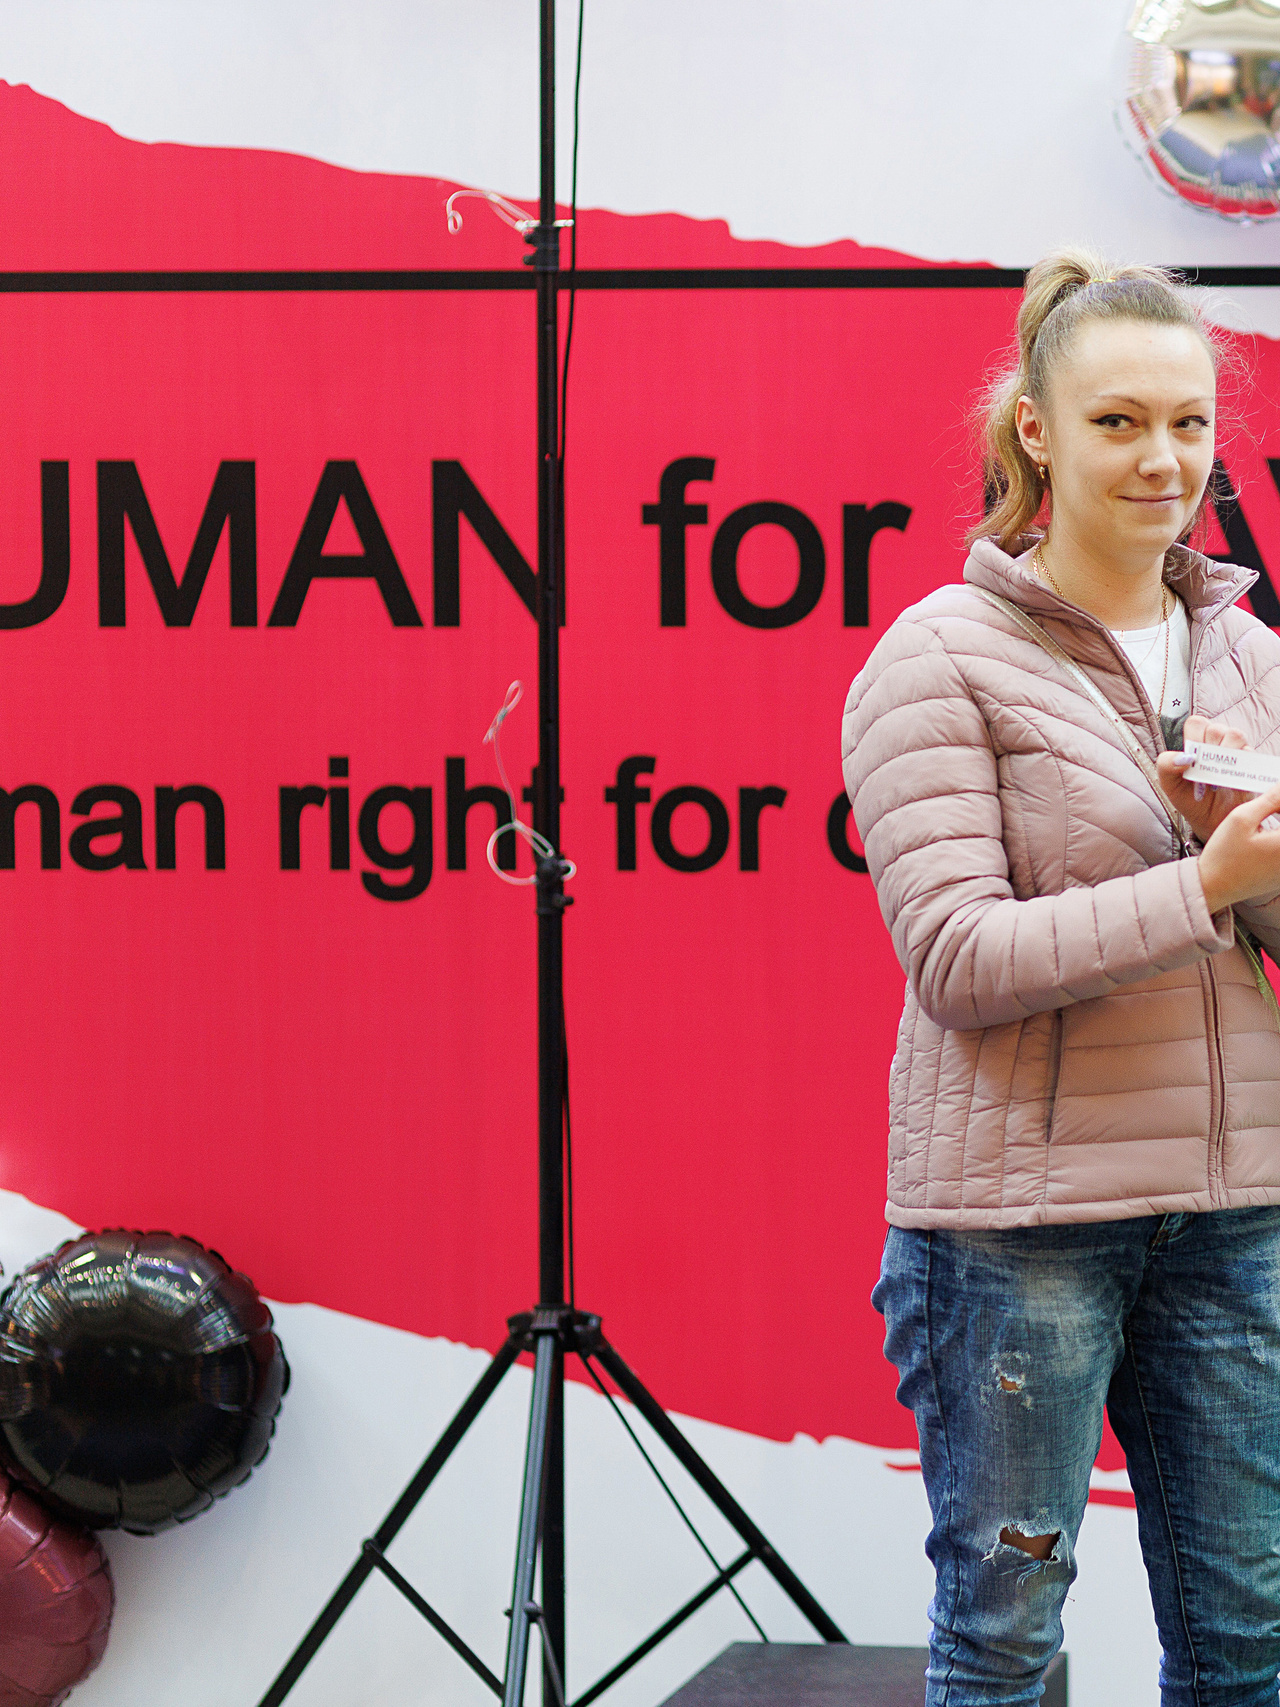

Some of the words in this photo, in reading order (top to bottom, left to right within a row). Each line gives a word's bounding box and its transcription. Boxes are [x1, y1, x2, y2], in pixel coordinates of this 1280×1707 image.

[641, 456, 913, 630] for
[604, 756, 788, 873] for
[1202, 751, 1238, 765] HUMAN
